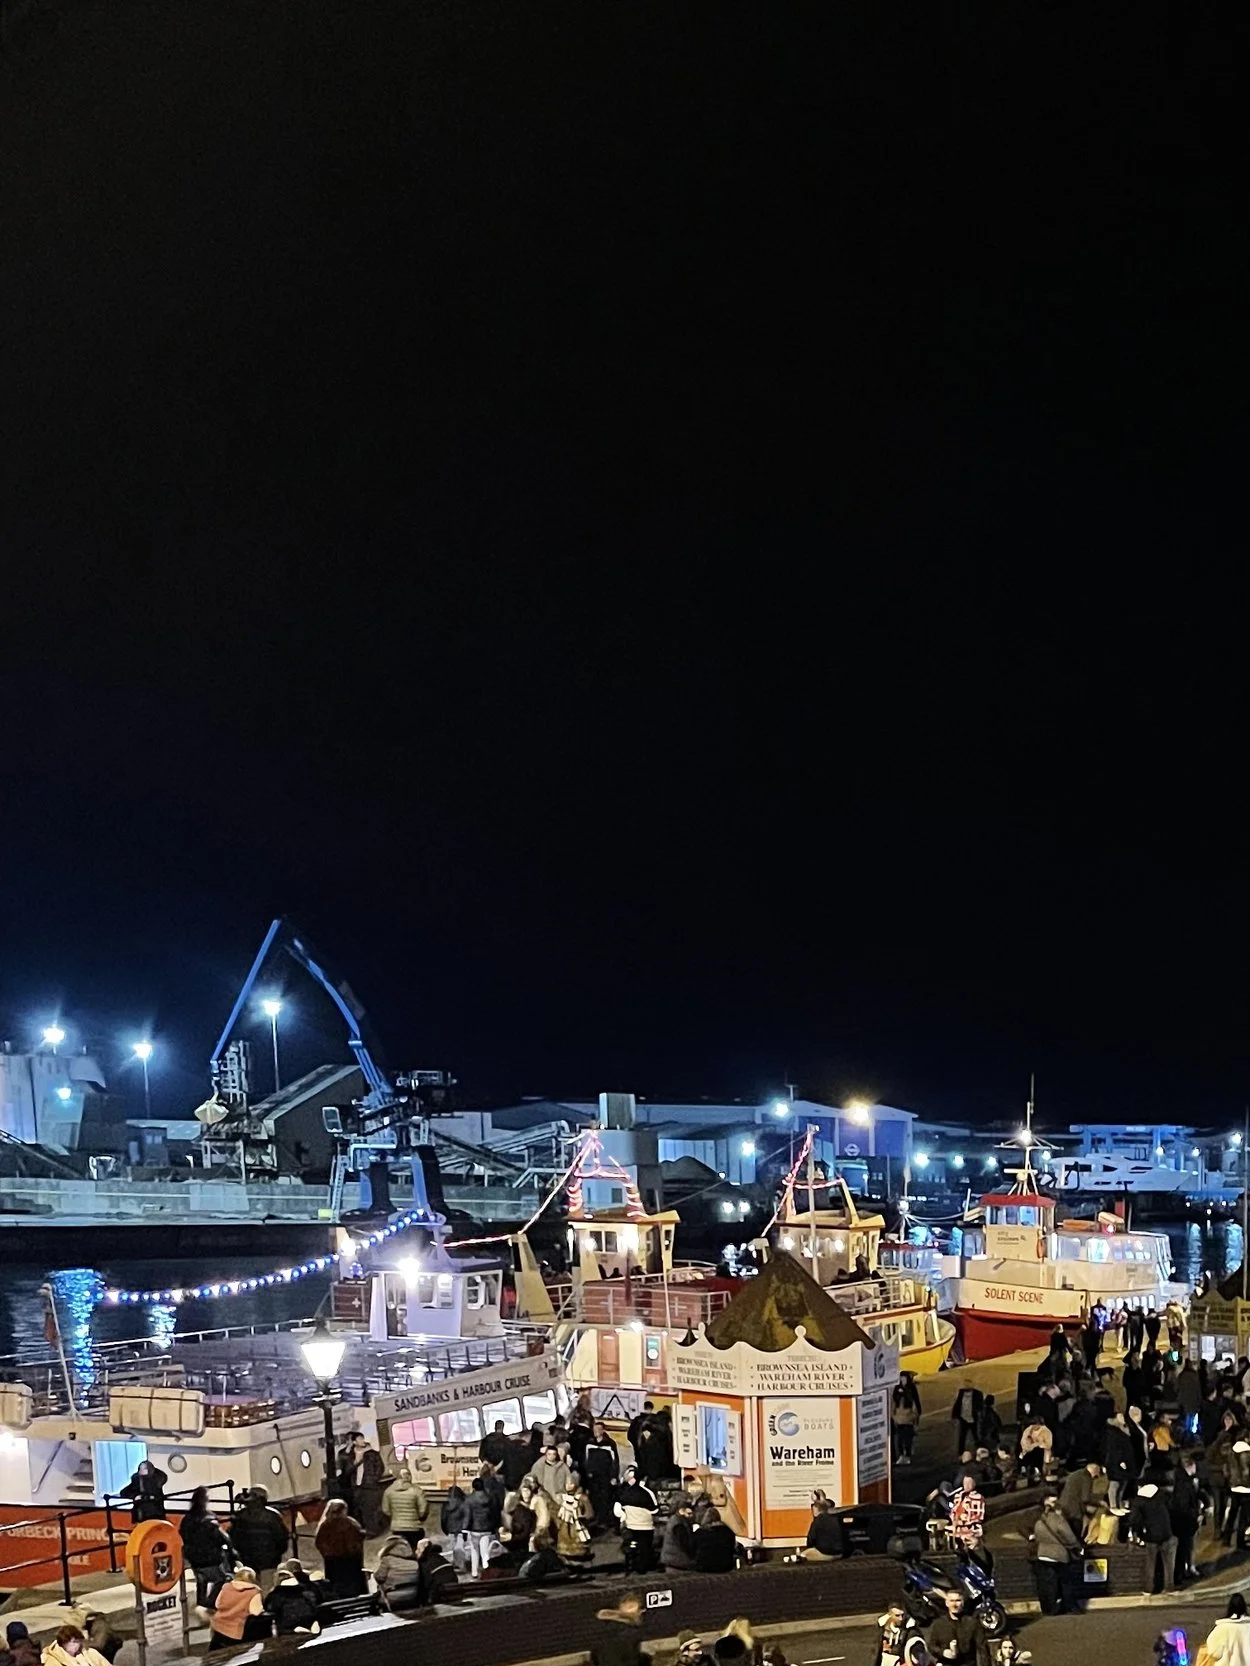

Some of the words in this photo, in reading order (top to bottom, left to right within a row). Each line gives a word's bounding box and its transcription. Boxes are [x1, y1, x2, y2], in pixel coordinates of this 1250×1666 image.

[984, 1287, 1016, 1301] SOLENT
[1018, 1292, 1044, 1304] SCENE
[760, 1373, 811, 1381] WAREHAM
[813, 1373, 845, 1381] RIVER
[395, 1390, 450, 1411] SANDBANKS
[453, 1390, 459, 1401] &
[463, 1381, 503, 1397] HARBOUR
[505, 1375, 530, 1389] CRUISE
[757, 1382, 807, 1391] HARBOUR
[808, 1382, 849, 1390] CRUISES
[770, 1446, 835, 1459] Wareham
[0, 1523, 60, 1539] URBECK
